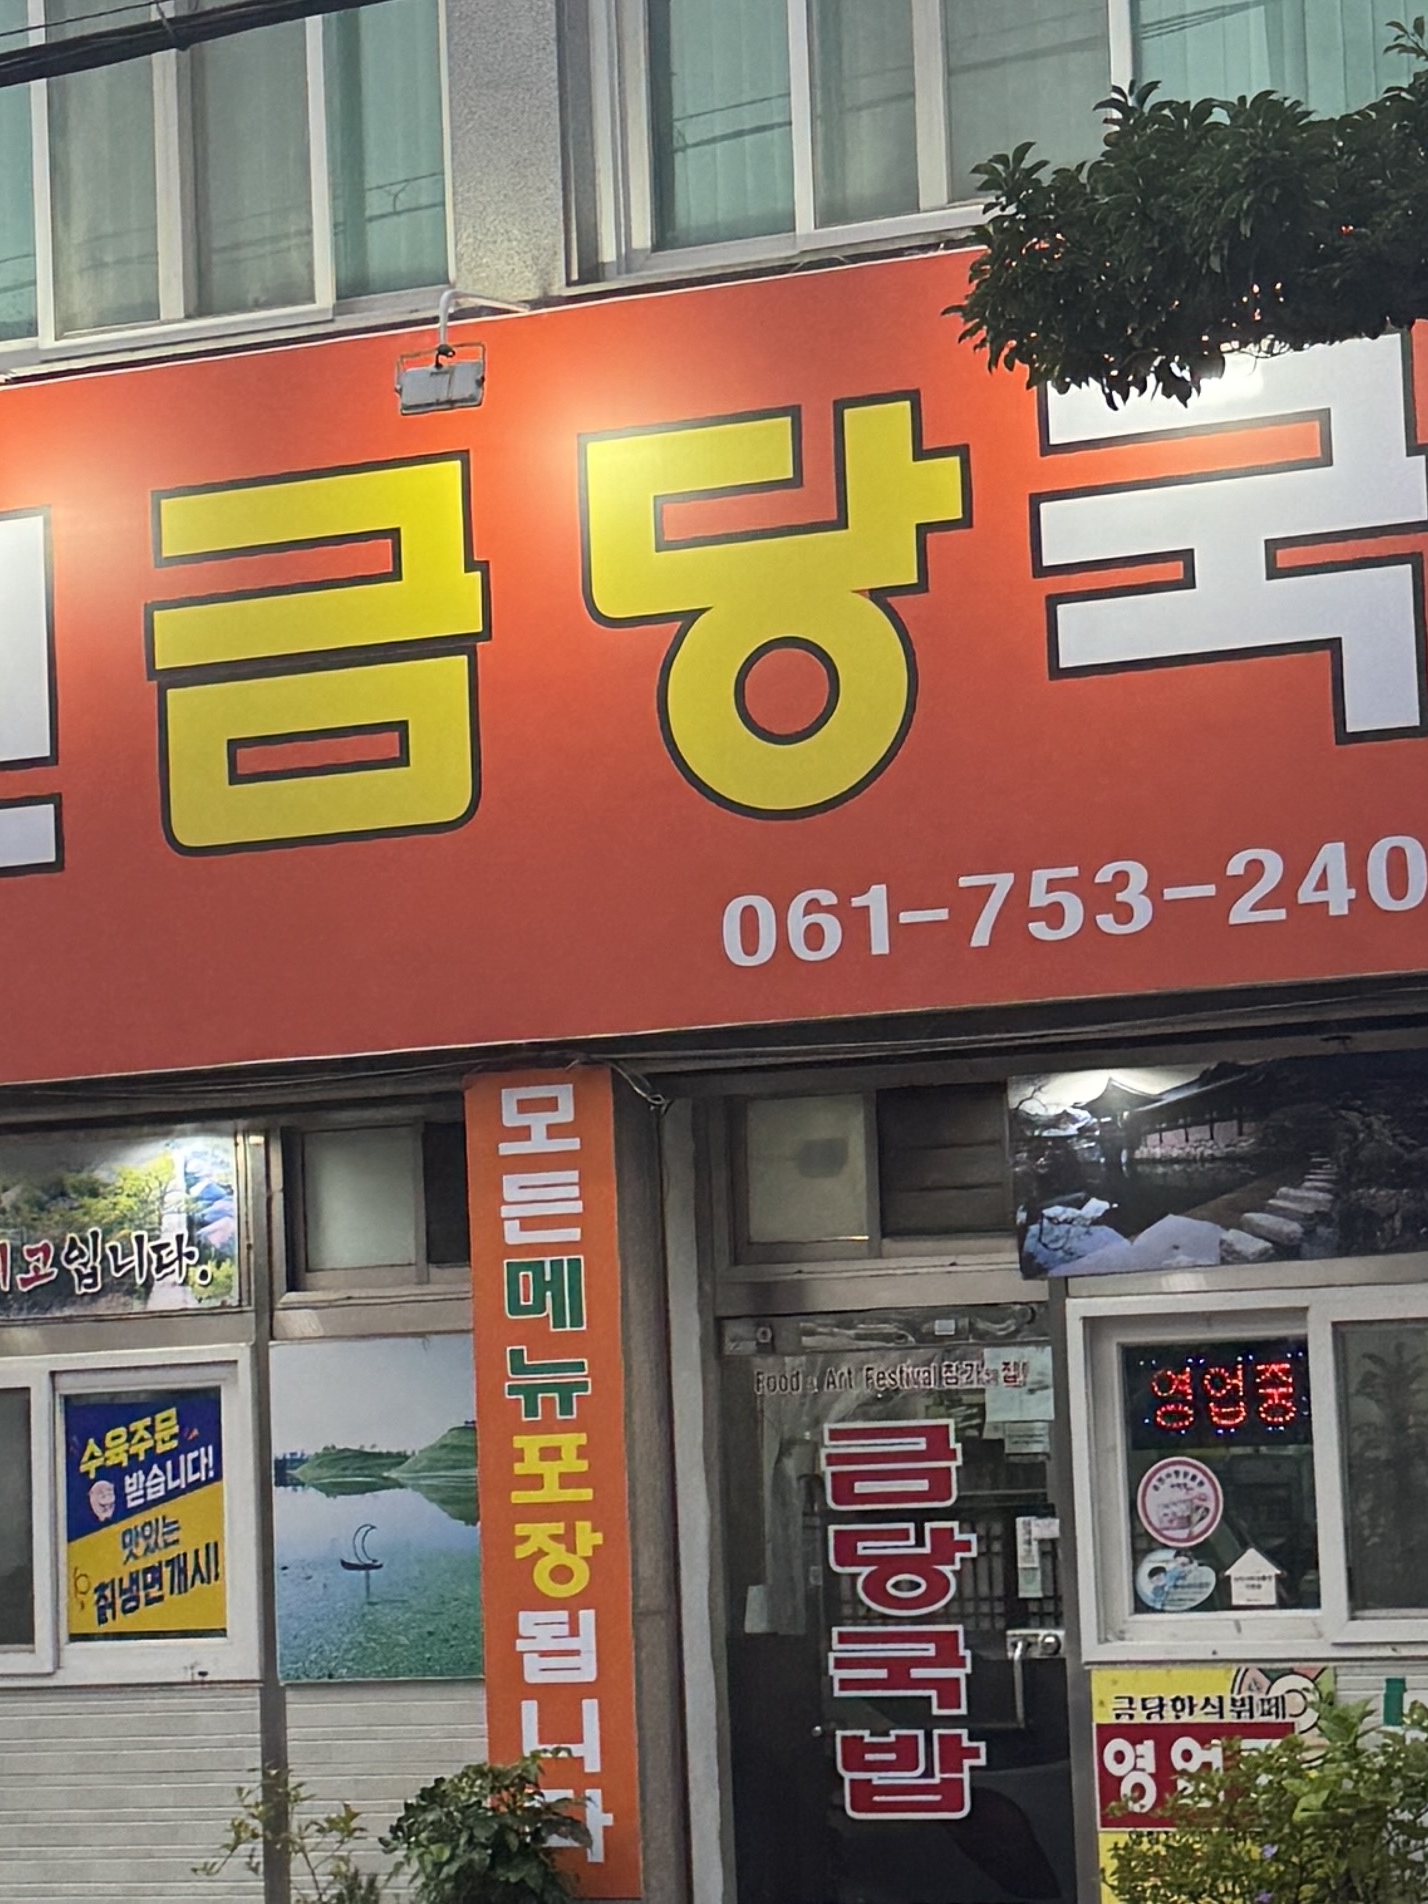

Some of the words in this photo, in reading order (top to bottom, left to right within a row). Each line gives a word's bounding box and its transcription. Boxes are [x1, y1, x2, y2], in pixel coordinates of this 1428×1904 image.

[755, 1369, 803, 1395] Food
[824, 1365, 854, 1391] Art
[864, 1360, 937, 1391] Festival
[1151, 1363, 1297, 1429] 영업중
[79, 1407, 180, 1479] 수육주문
[124, 1444, 215, 1509] 받습니다!
[121, 1515, 182, 1565] 맛있는
[821, 1419, 987, 1821] 금당국밥
[1112, 1694, 1288, 1721] 금당한식뷔페
